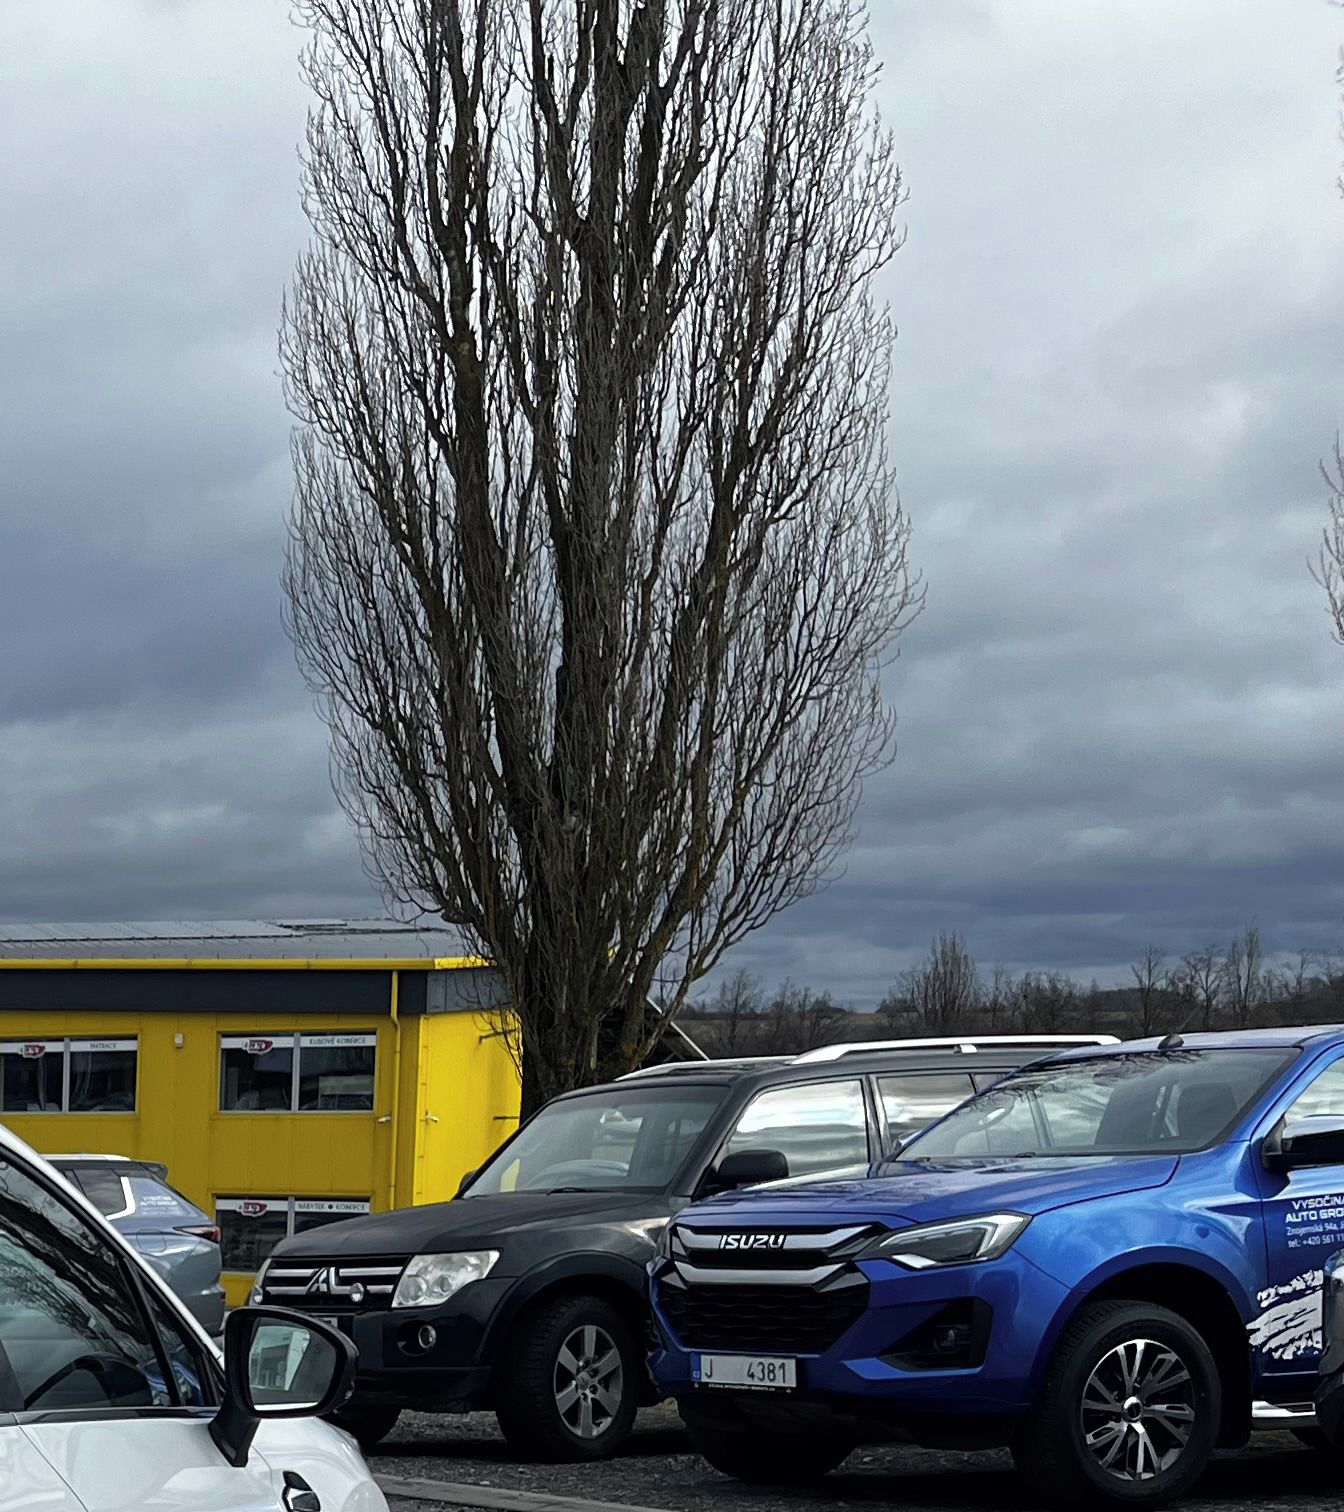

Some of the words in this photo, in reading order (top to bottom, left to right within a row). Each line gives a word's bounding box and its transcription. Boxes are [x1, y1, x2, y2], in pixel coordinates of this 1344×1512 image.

[1286, 1210, 1318, 1223] AUTO
[1319, 1208, 1344, 1219] GRO
[720, 1234, 785, 1250] ISUZU
[746, 1361, 787, 1384] 4381
